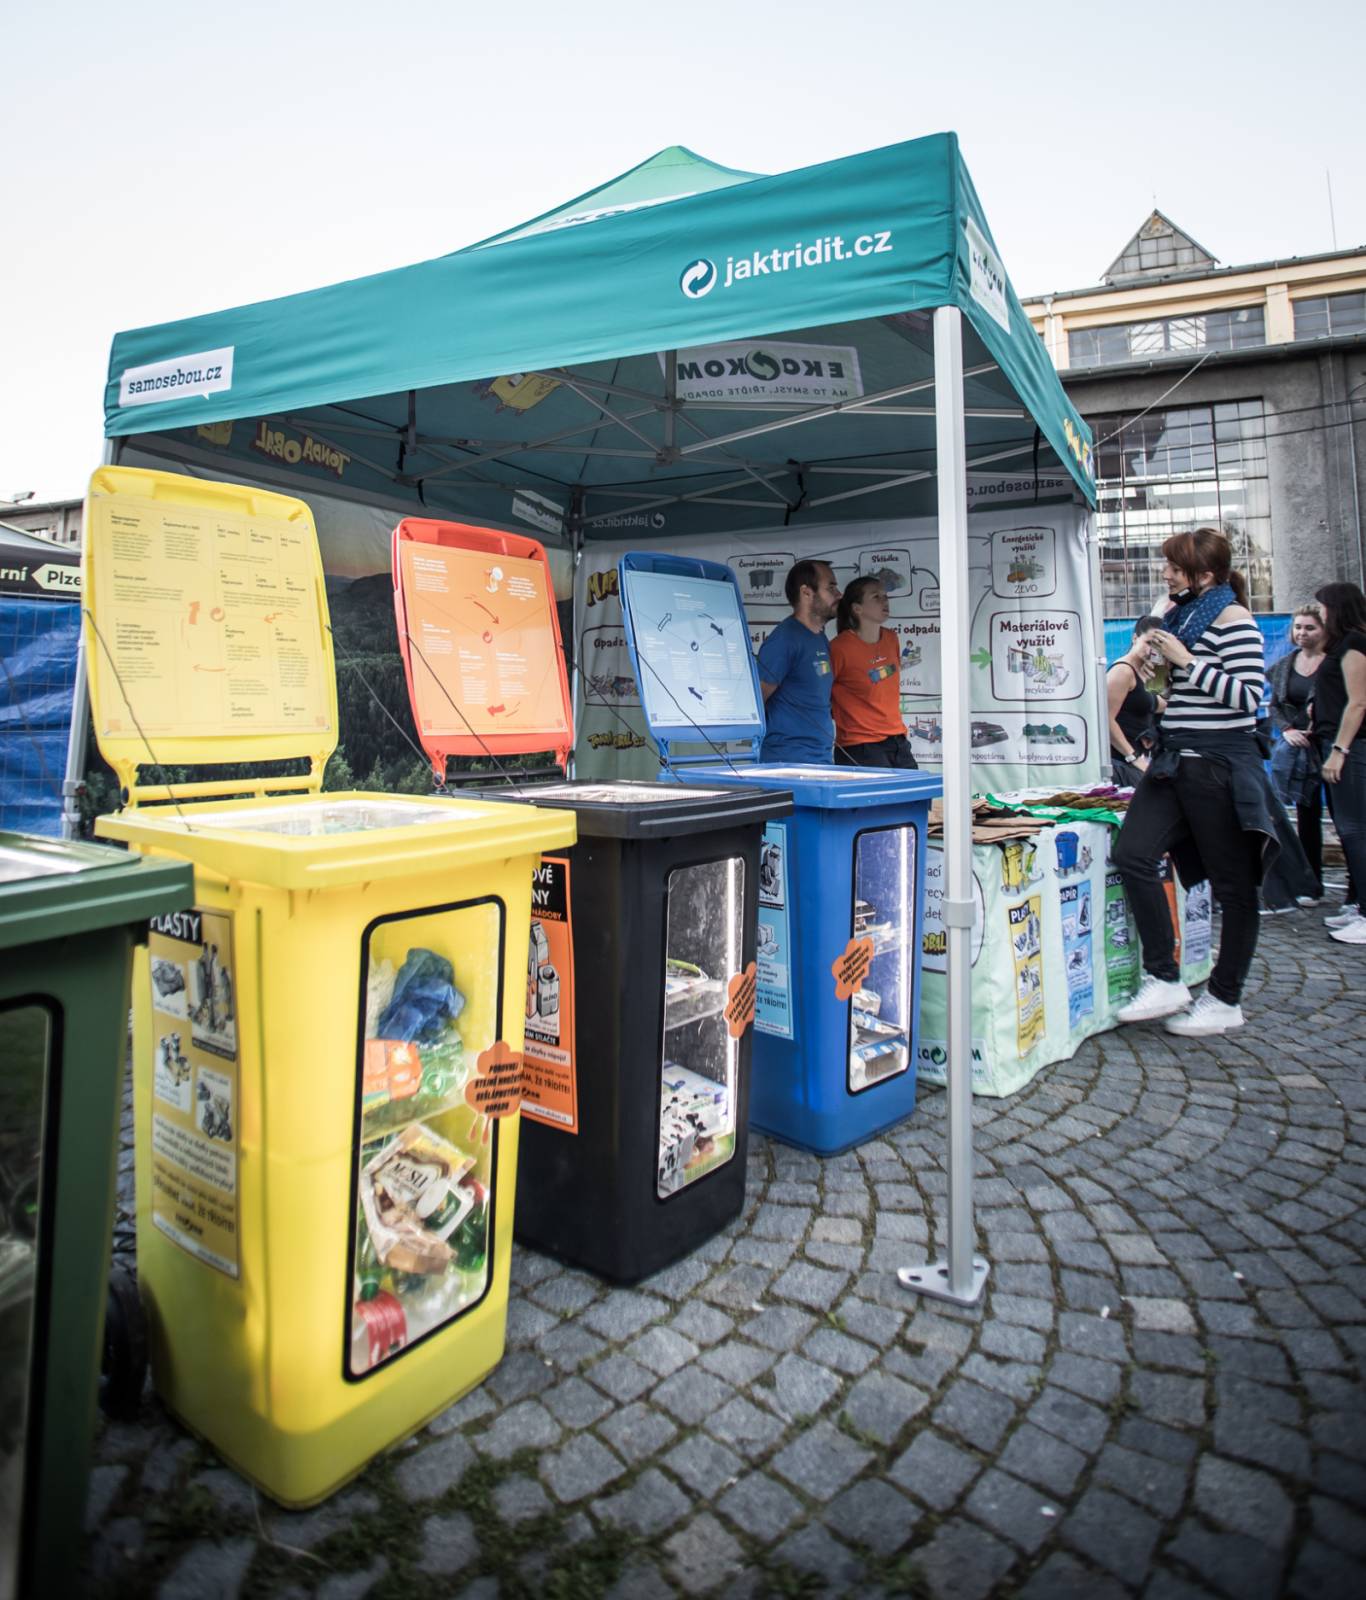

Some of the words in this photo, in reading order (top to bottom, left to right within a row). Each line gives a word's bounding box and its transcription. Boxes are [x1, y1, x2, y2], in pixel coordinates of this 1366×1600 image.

[724, 231, 893, 287] jaktridit.cz
[128, 366, 222, 394] samosebou.cz
[0, 566, 28, 581] rní
[47, 570, 81, 586] Plze
[1000, 619, 1069, 632] Materiálové
[1016, 634, 1055, 649] využití
[927, 864, 941, 877] ací
[532, 889, 550, 906] NY
